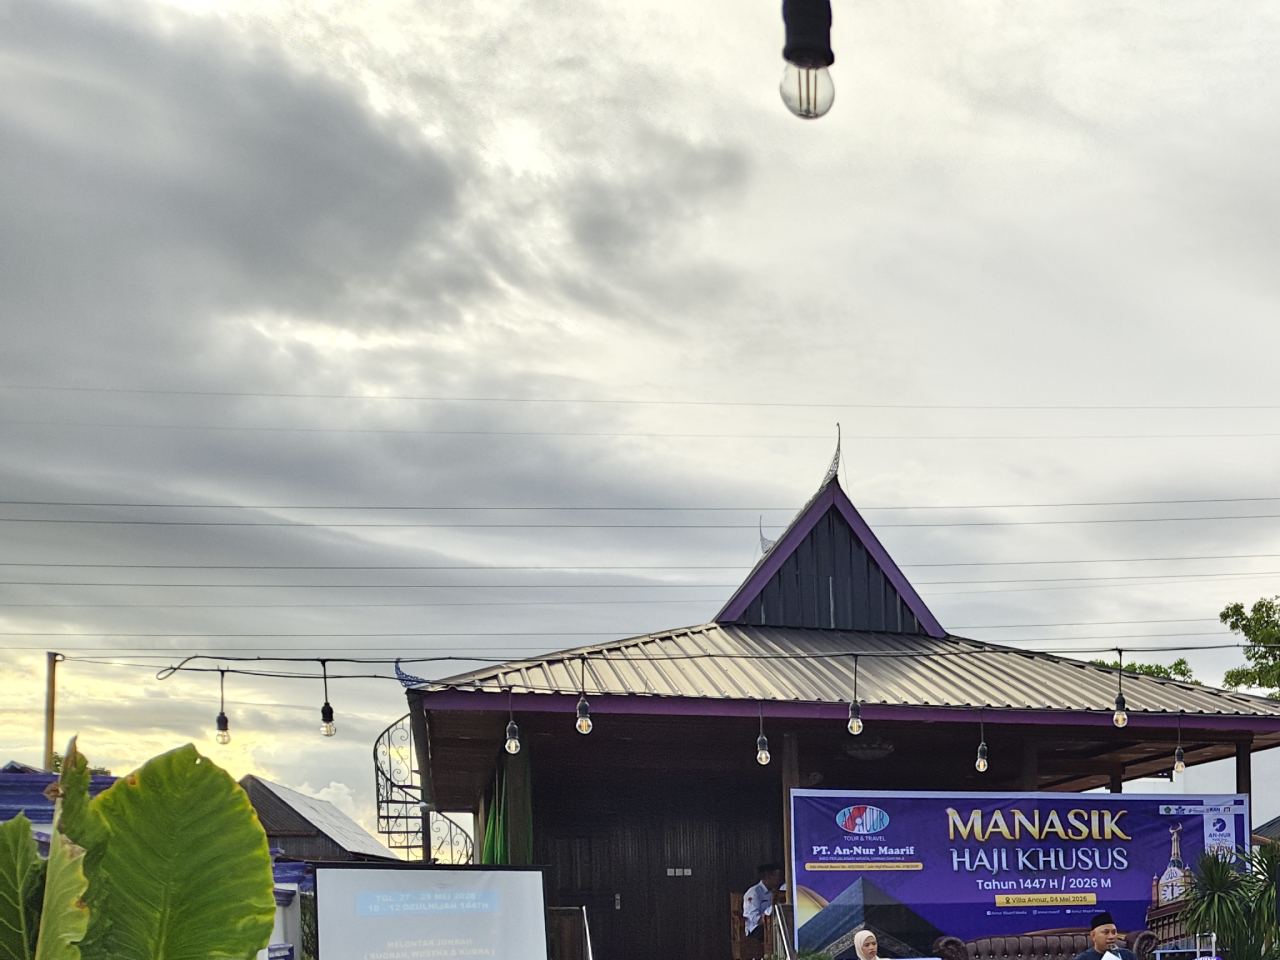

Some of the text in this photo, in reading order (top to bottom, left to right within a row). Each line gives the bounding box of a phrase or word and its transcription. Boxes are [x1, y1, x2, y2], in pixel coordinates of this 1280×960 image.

[946, 807, 1132, 841] MANASIK
[812, 845, 915, 855] PT. An-Nur Maarif
[949, 847, 1128, 875] HAJI KHUSUS
[976, 876, 1112, 891] Tahun 1447 H / 2026 M
[1027, 896, 1049, 904] Annur,
[389, 903, 401, 911] 12
[403, 902, 457, 911] DZULHIJAH
[386, 938, 473, 949] MELONTAR JUMRAH
[411, 949, 449, 958] WUSTHA
